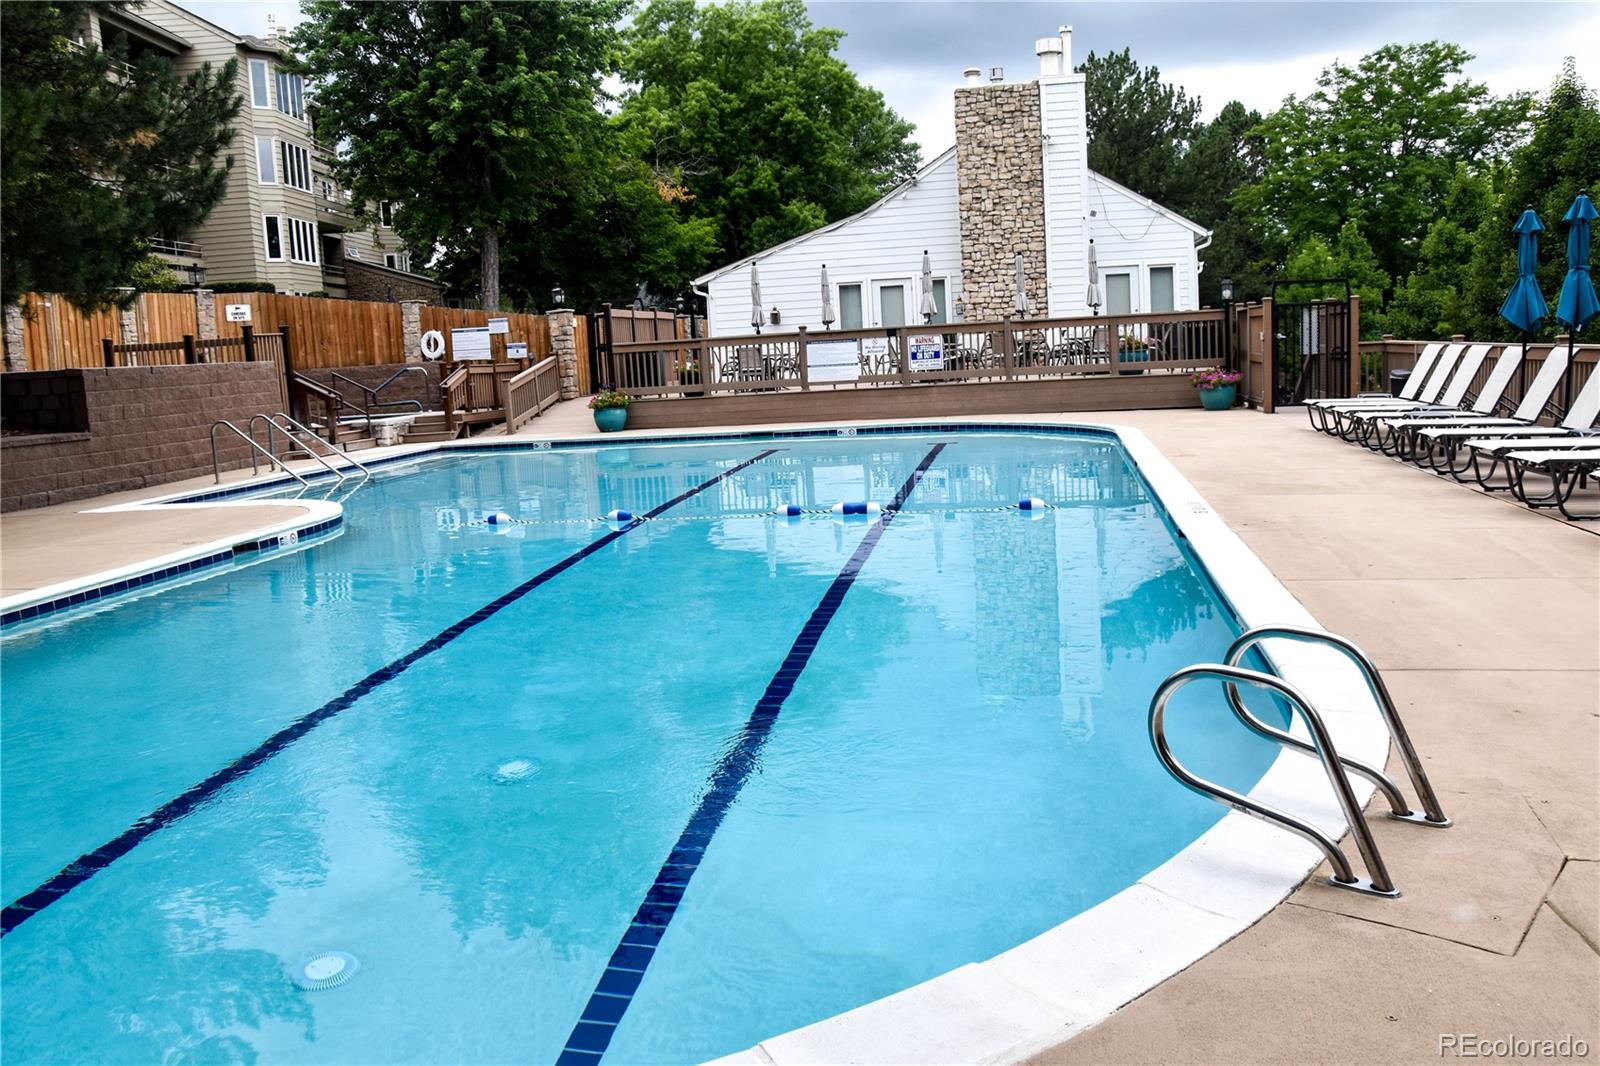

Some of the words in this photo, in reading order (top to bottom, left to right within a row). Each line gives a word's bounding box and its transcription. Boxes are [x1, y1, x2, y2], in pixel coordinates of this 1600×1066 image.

[914, 336, 935, 344] WARNING
[911, 345, 918, 353] NO
[918, 344, 940, 353] LIFEGUARD
[916, 351, 923, 359] ON
[923, 350, 935, 359] DUTY
